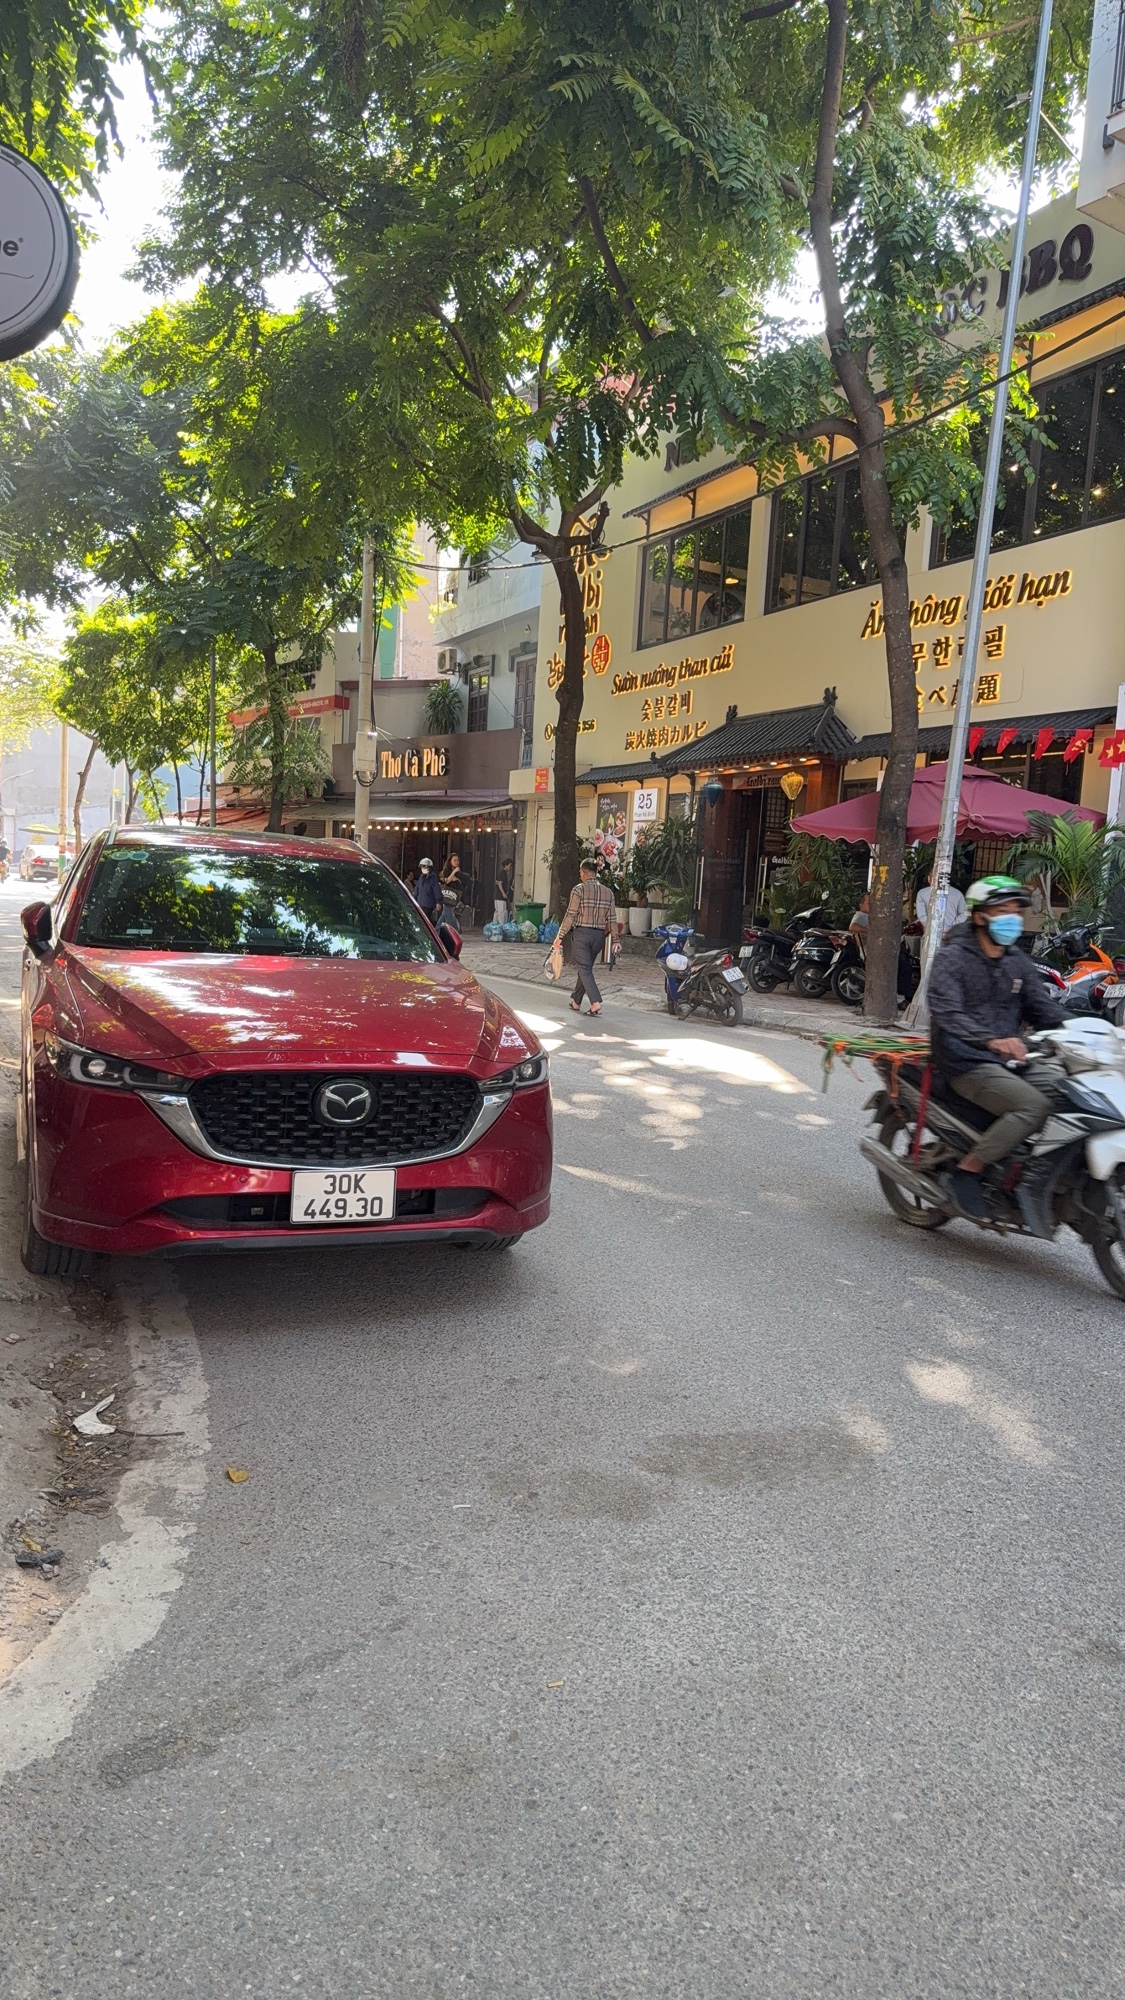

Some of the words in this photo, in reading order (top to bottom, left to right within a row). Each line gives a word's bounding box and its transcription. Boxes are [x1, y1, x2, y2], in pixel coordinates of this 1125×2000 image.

[909, 593, 964, 627] hông
[1016, 570, 1072, 608] hạn
[679, 657, 709, 681] than
[404, 749, 419, 778] Cà
[422, 747, 446, 777] Phê
[638, 792, 653, 810] 25
[323, 1173, 367, 1195] 30K
[303, 1196, 383, 1219] 449.30
